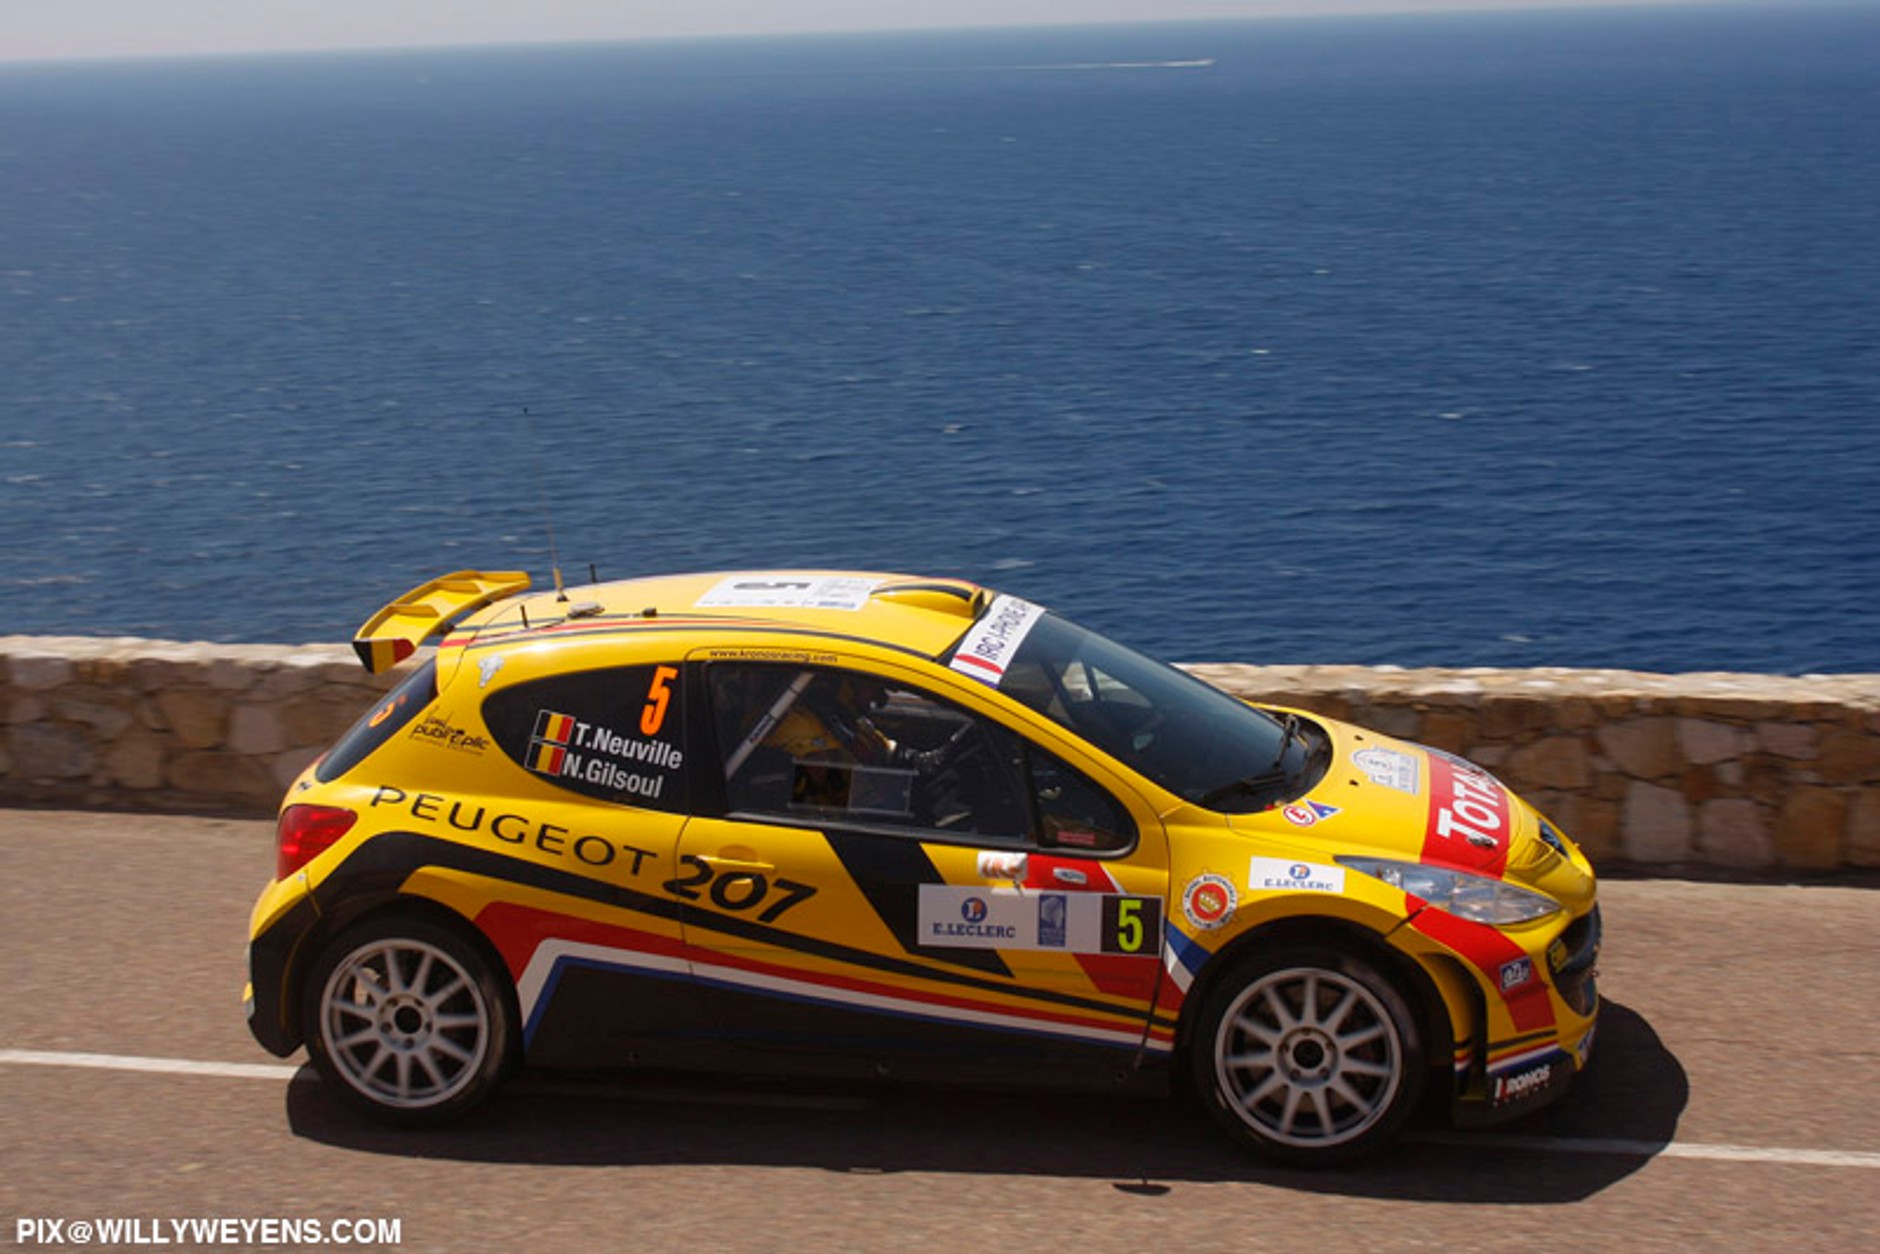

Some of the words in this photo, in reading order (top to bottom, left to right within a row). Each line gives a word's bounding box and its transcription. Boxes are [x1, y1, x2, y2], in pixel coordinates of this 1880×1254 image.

[640, 665, 678, 736] 5
[575, 722, 684, 770] T.Neuville
[562, 753, 664, 799] N.Gilsoul
[369, 784, 659, 876] PEUGEOT
[662, 854, 819, 924] 207
[1263, 878, 1335, 891] E.LECLERC
[932, 922, 1016, 938] E.LECLERC
[1117, 899, 1144, 953] 5
